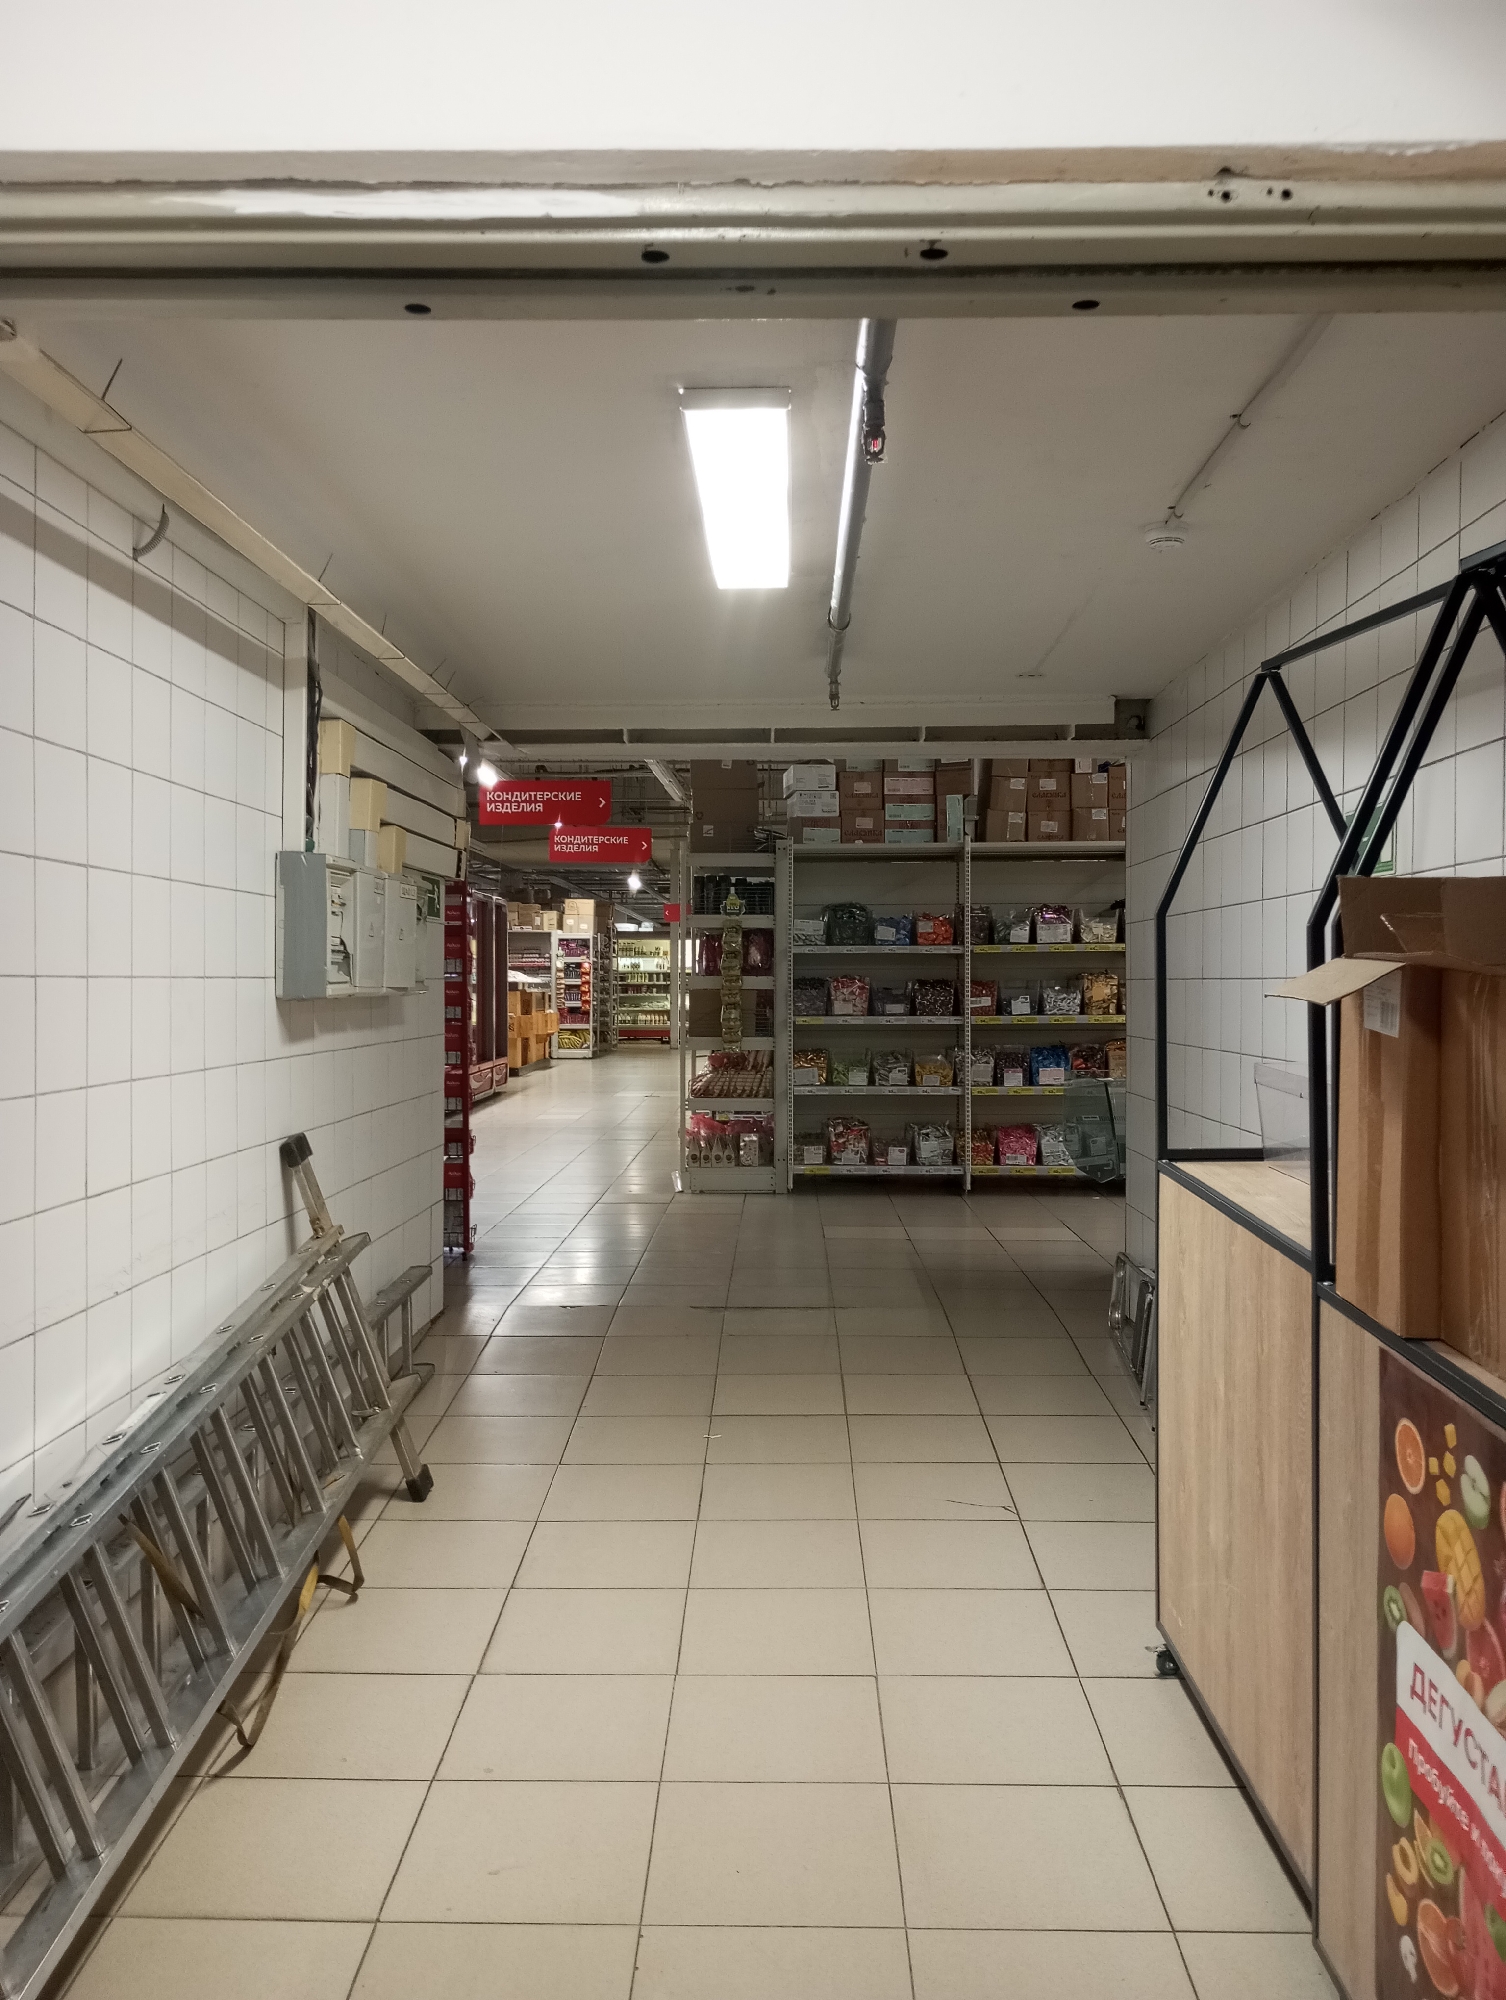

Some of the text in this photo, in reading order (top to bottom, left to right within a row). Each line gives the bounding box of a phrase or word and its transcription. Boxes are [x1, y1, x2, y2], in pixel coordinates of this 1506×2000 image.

[486, 791, 582, 802] КОНДИТЕРСКИЕ
[486, 803, 543, 813] ИЗДЕЛИЯ
[554, 835, 629, 845] КОНДИТЕРСКИЕ
[554, 844, 599, 852] ИЗДЕЛИЯ
